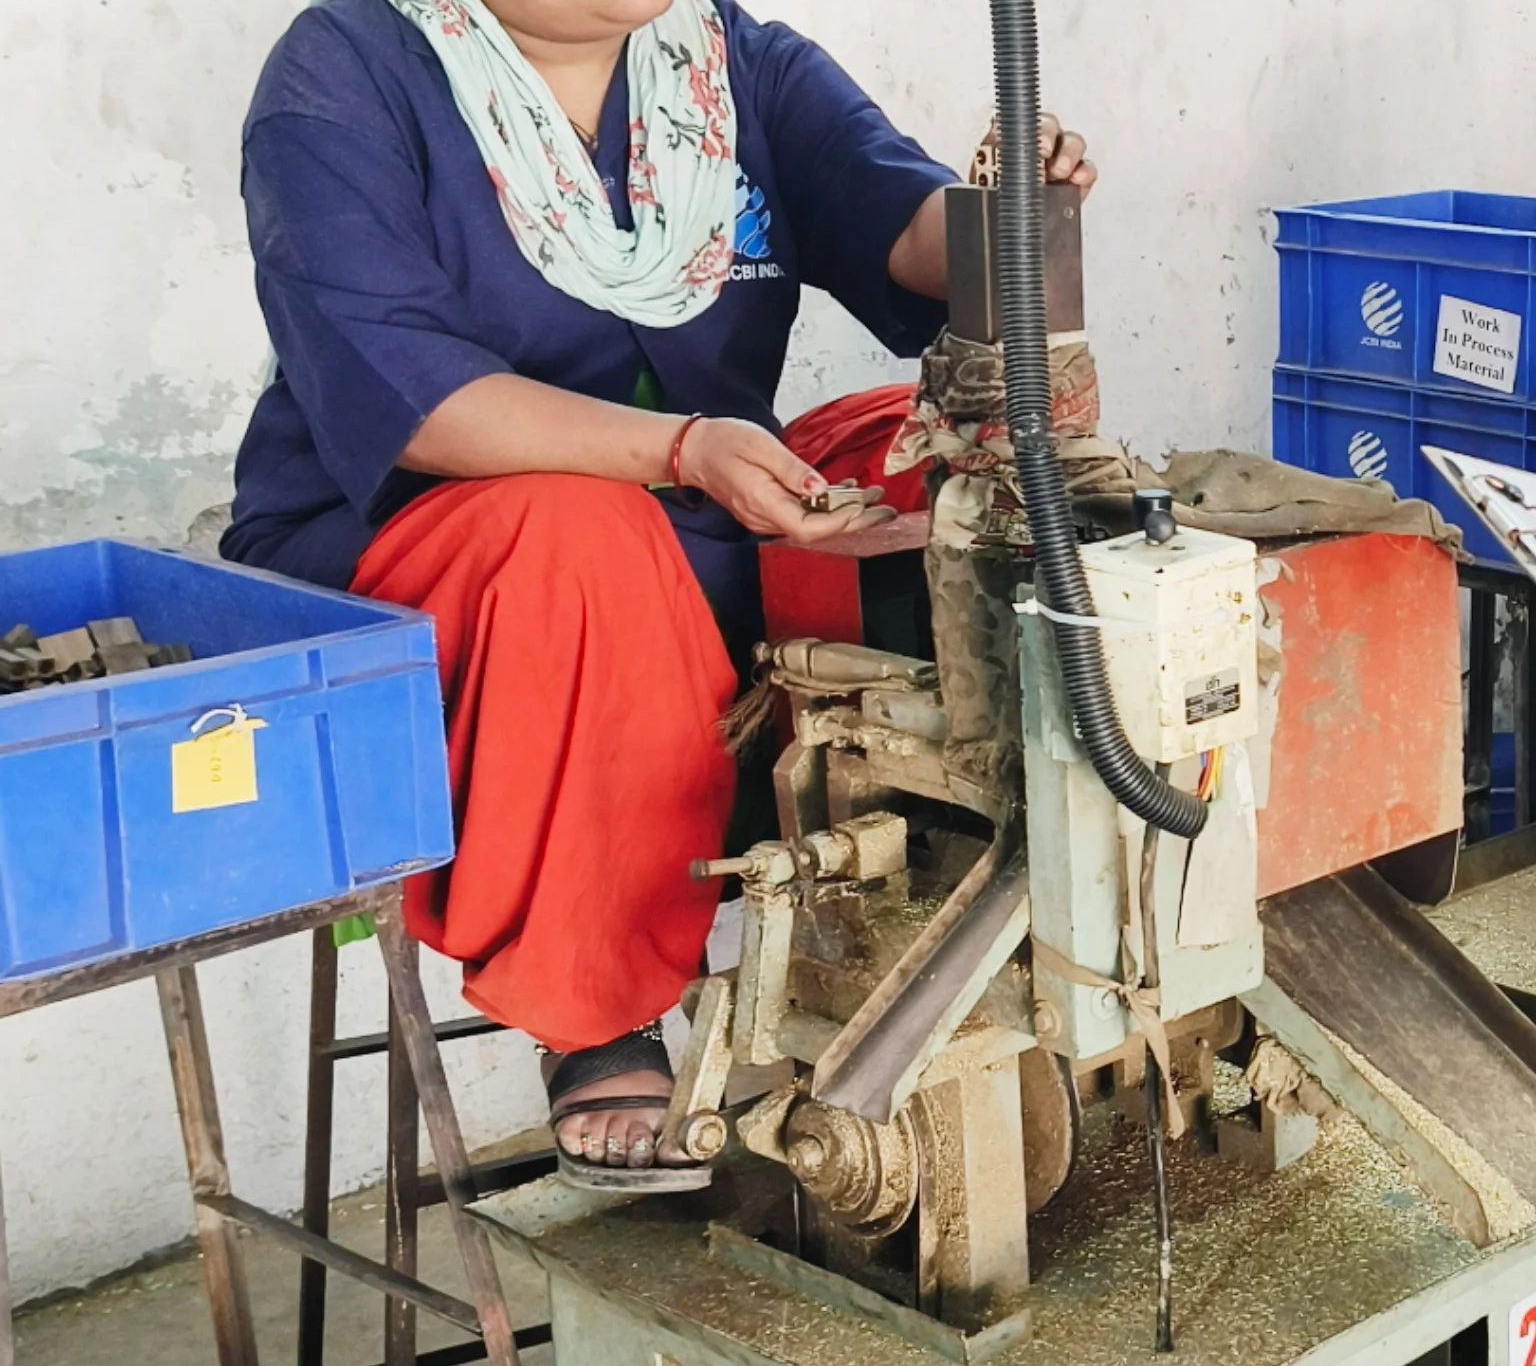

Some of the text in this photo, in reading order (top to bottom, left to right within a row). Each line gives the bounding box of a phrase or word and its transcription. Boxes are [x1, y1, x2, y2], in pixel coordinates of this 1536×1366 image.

[1461, 309, 1501, 333] Work
[1443, 328, 1514, 361] In Process
[1447, 352, 1504, 381] Material
